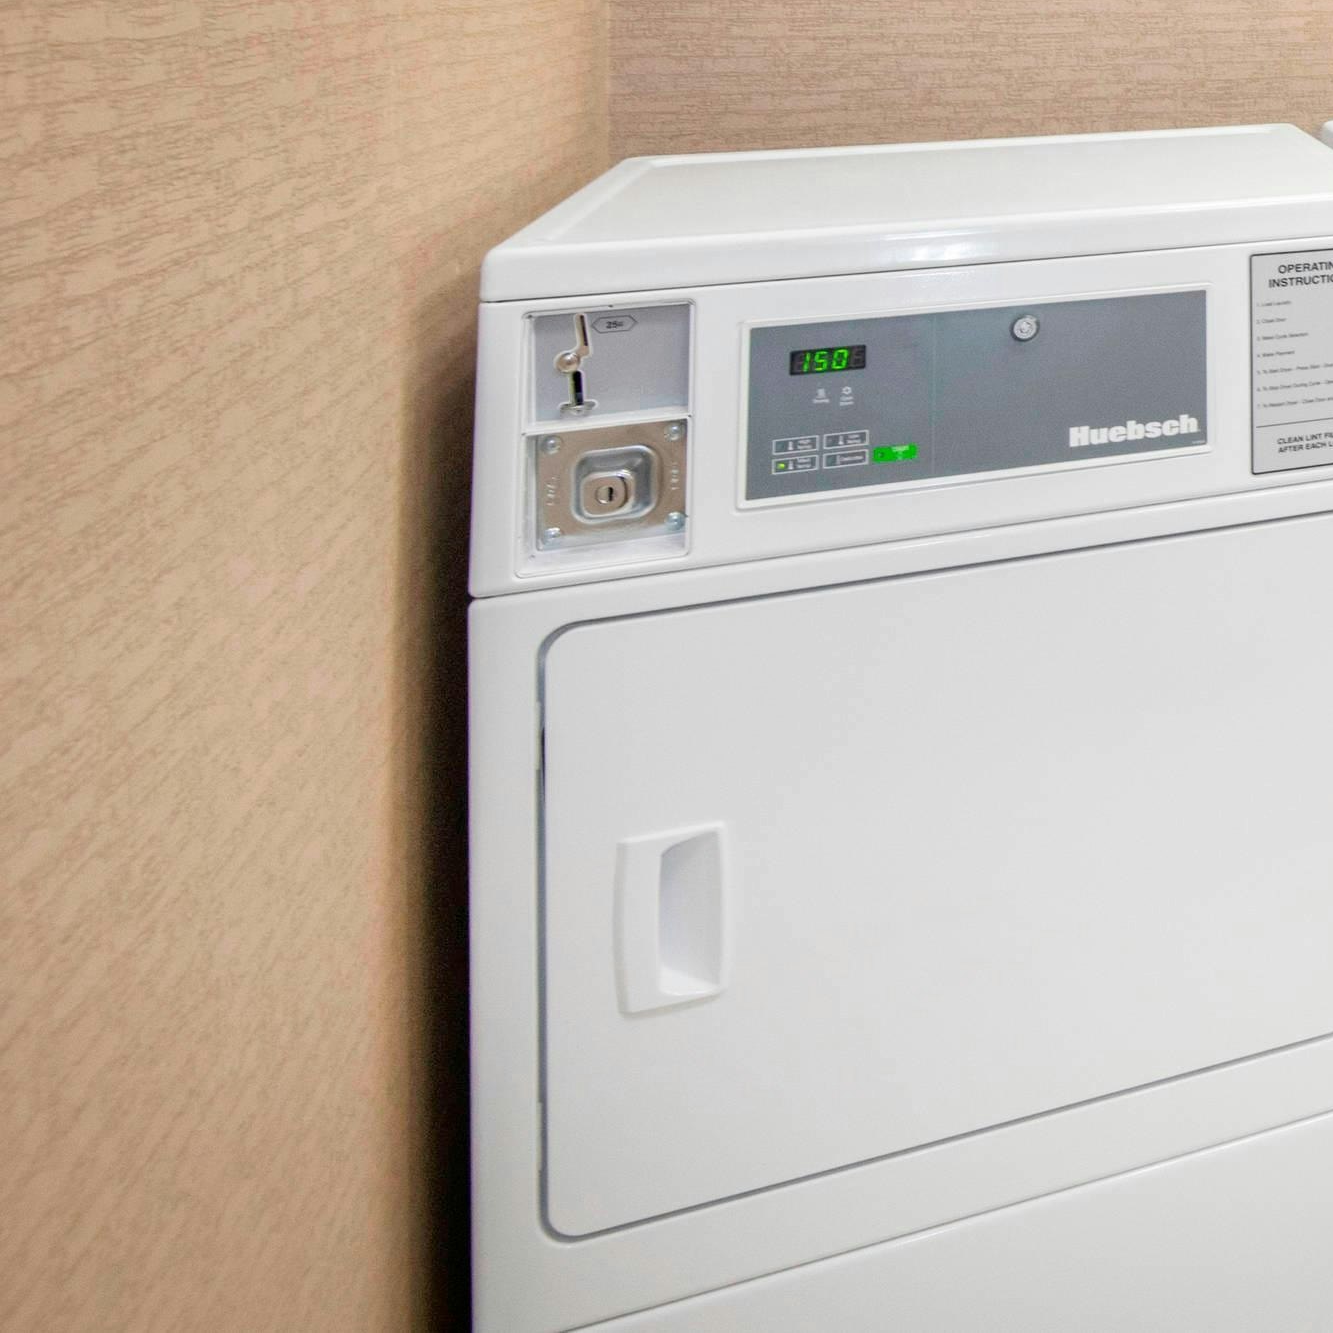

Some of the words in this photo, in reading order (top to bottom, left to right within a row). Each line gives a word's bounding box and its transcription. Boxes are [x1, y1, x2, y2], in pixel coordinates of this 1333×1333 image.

[803, 348, 850, 372] 150
[1069, 414, 1199, 448] Huebsch
[1277, 434, 1304, 445] CLEAN
[1305, 432, 1322, 442] LINT
[1278, 443, 1304, 453] AFTER
[1305, 441, 1327, 450] EACH
